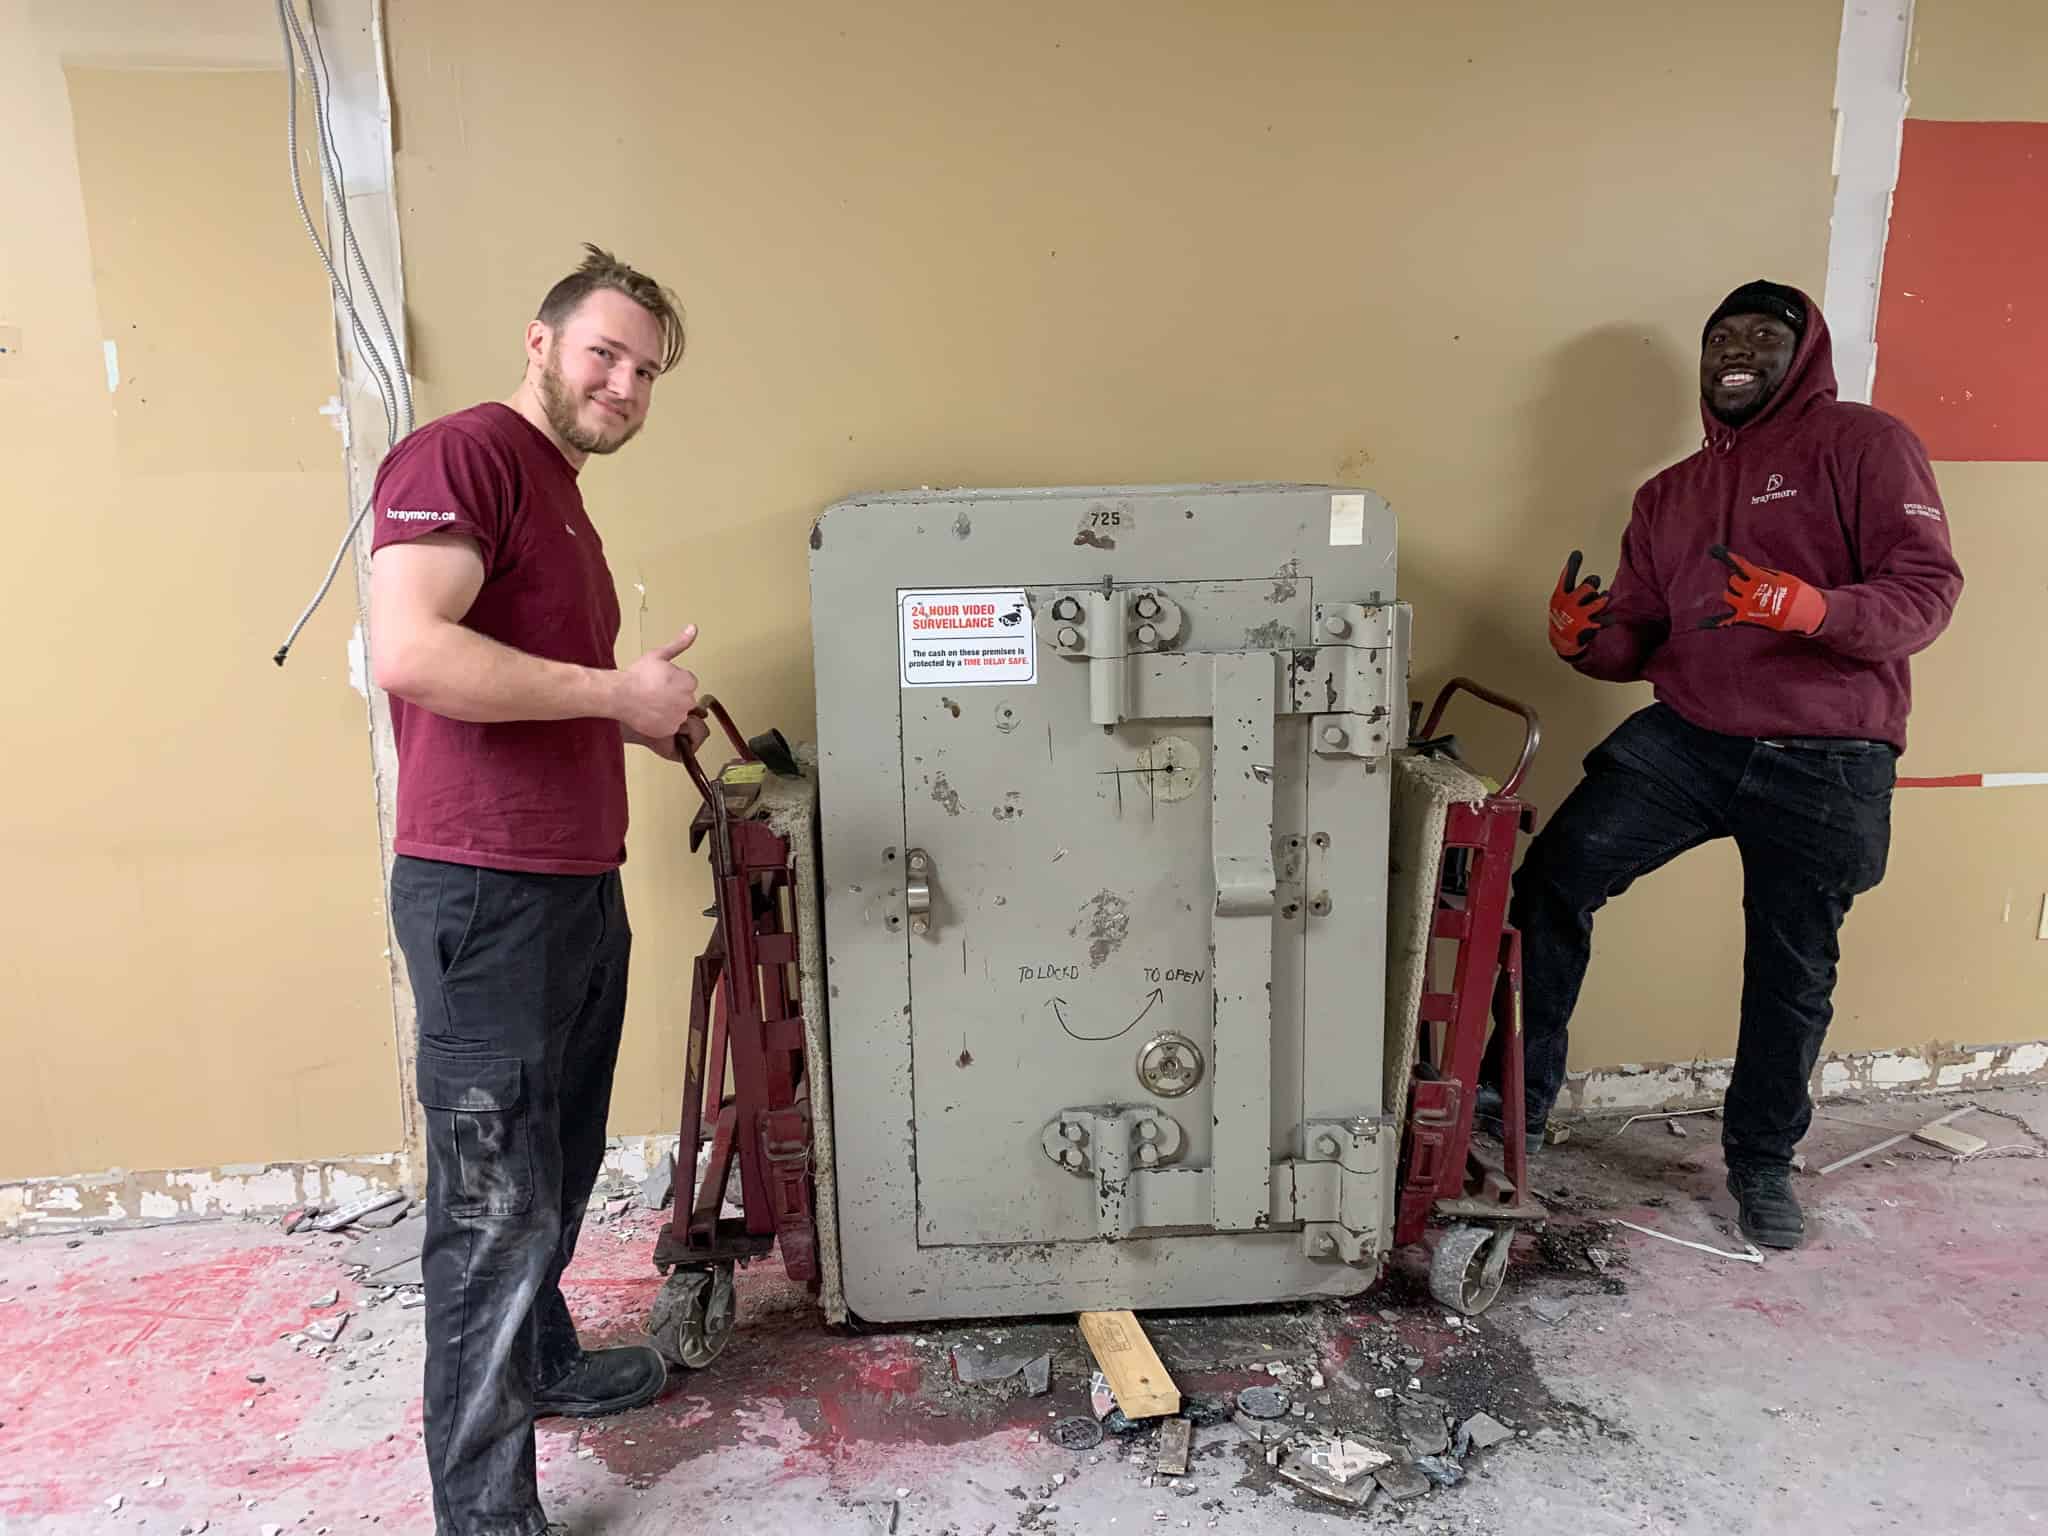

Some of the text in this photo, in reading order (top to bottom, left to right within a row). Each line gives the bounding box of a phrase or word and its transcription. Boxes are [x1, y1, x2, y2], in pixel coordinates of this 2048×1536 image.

[386, 507, 456, 522] braymore.ca
[1090, 511, 1120, 526] 725
[911, 604, 995, 617] 24 HOUR VIDEO
[912, 617, 995, 630] SURVEILLANCE
[912, 649, 927, 657] The
[928, 649, 946, 657] cash
[959, 648, 980, 656] these
[981, 647, 1016, 657] premises
[1017, 647, 1025, 656] is
[908, 659, 945, 669] protected
[946, 658, 956, 668] by
[963, 658, 981, 666] TIME
[983, 657, 1006, 665] DELAY
[1018, 965, 1034, 984] TO
[1143, 967, 1205, 985] TO OPEN
